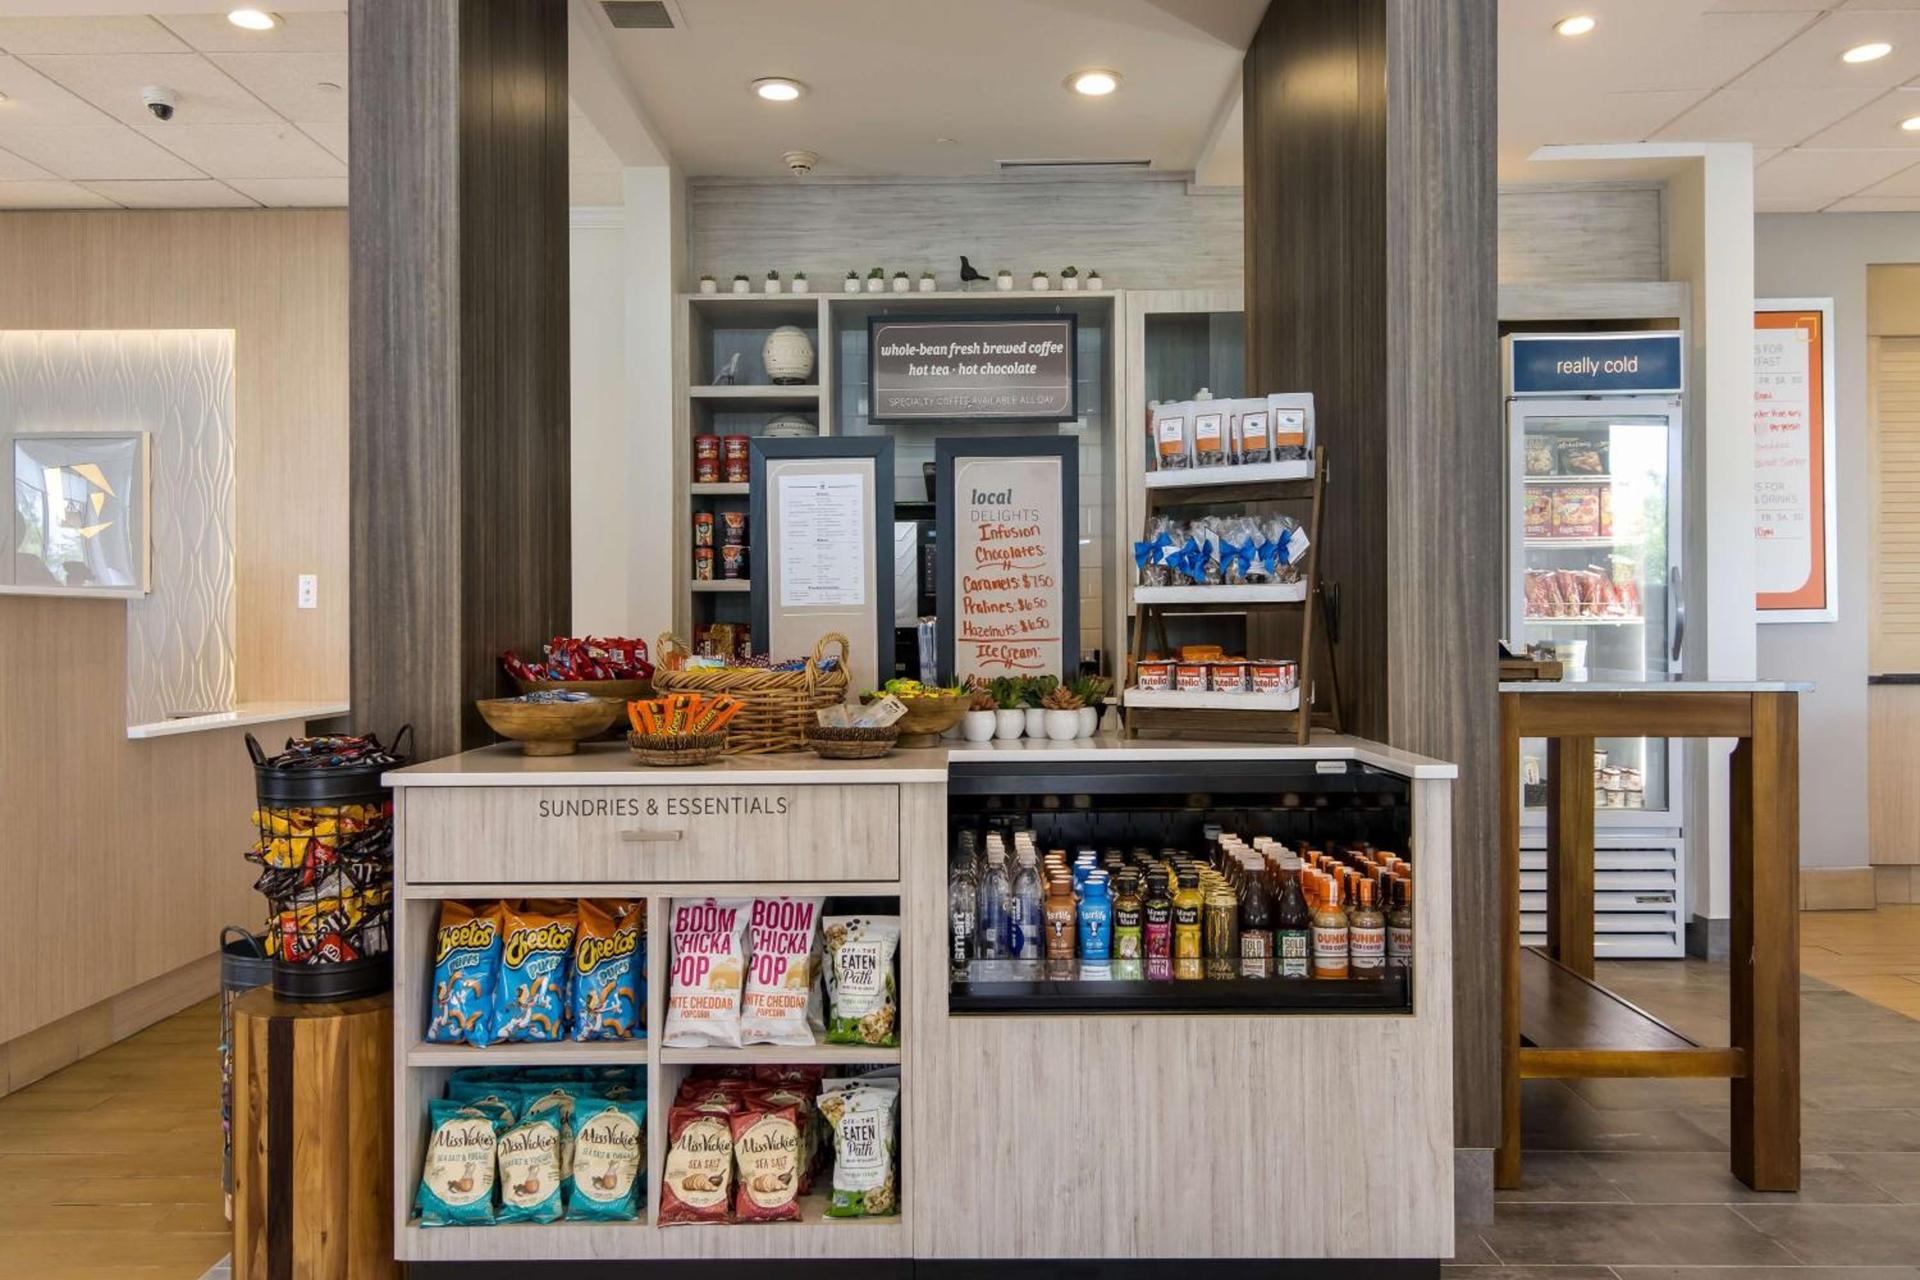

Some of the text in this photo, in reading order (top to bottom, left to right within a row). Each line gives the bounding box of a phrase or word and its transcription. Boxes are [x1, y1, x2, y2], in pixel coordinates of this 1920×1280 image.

[881, 341, 1064, 358] whole-bean fresh brewed coffee
[909, 361, 1037, 376] hot tea hot chocolate
[1557, 355, 1638, 377] really cold
[971, 489, 1012, 505] local
[971, 509, 1039, 521] DELIGHTS
[979, 523, 1041, 542] Infusion
[1141, 676, 1167, 685] nutella
[539, 796, 788, 817] SUNDRIES & ESSENTIALS
[675, 905, 737, 933] BOOM
[752, 899, 814, 931] BOOM
[505, 921, 573, 969] Cheetos
[675, 932, 731, 955] CHICKA
[751, 929, 807, 954] CHICKA
[578, 929, 637, 975] Cheetos
[750, 953, 788, 986] POP
[841, 954, 876, 970] EATEN
[672, 956, 710, 987] POP
[843, 968, 872, 985] Path
[690, 995, 733, 1009] CHEDDAR
[767, 994, 806, 1009] CHEDDAR
[435, 1131, 462, 1148] Miss
[581, 1128, 608, 1144] Miss
[843, 1125, 876, 1141] EATEN
[501, 1137, 523, 1156] Miss
[677, 1134, 703, 1152] Miss
[742, 1138, 767, 1154] Miss
[846, 1140, 874, 1157] Path
[689, 1158, 721, 1169] SEA SALT
[755, 1156, 788, 1168] SEA SALT
